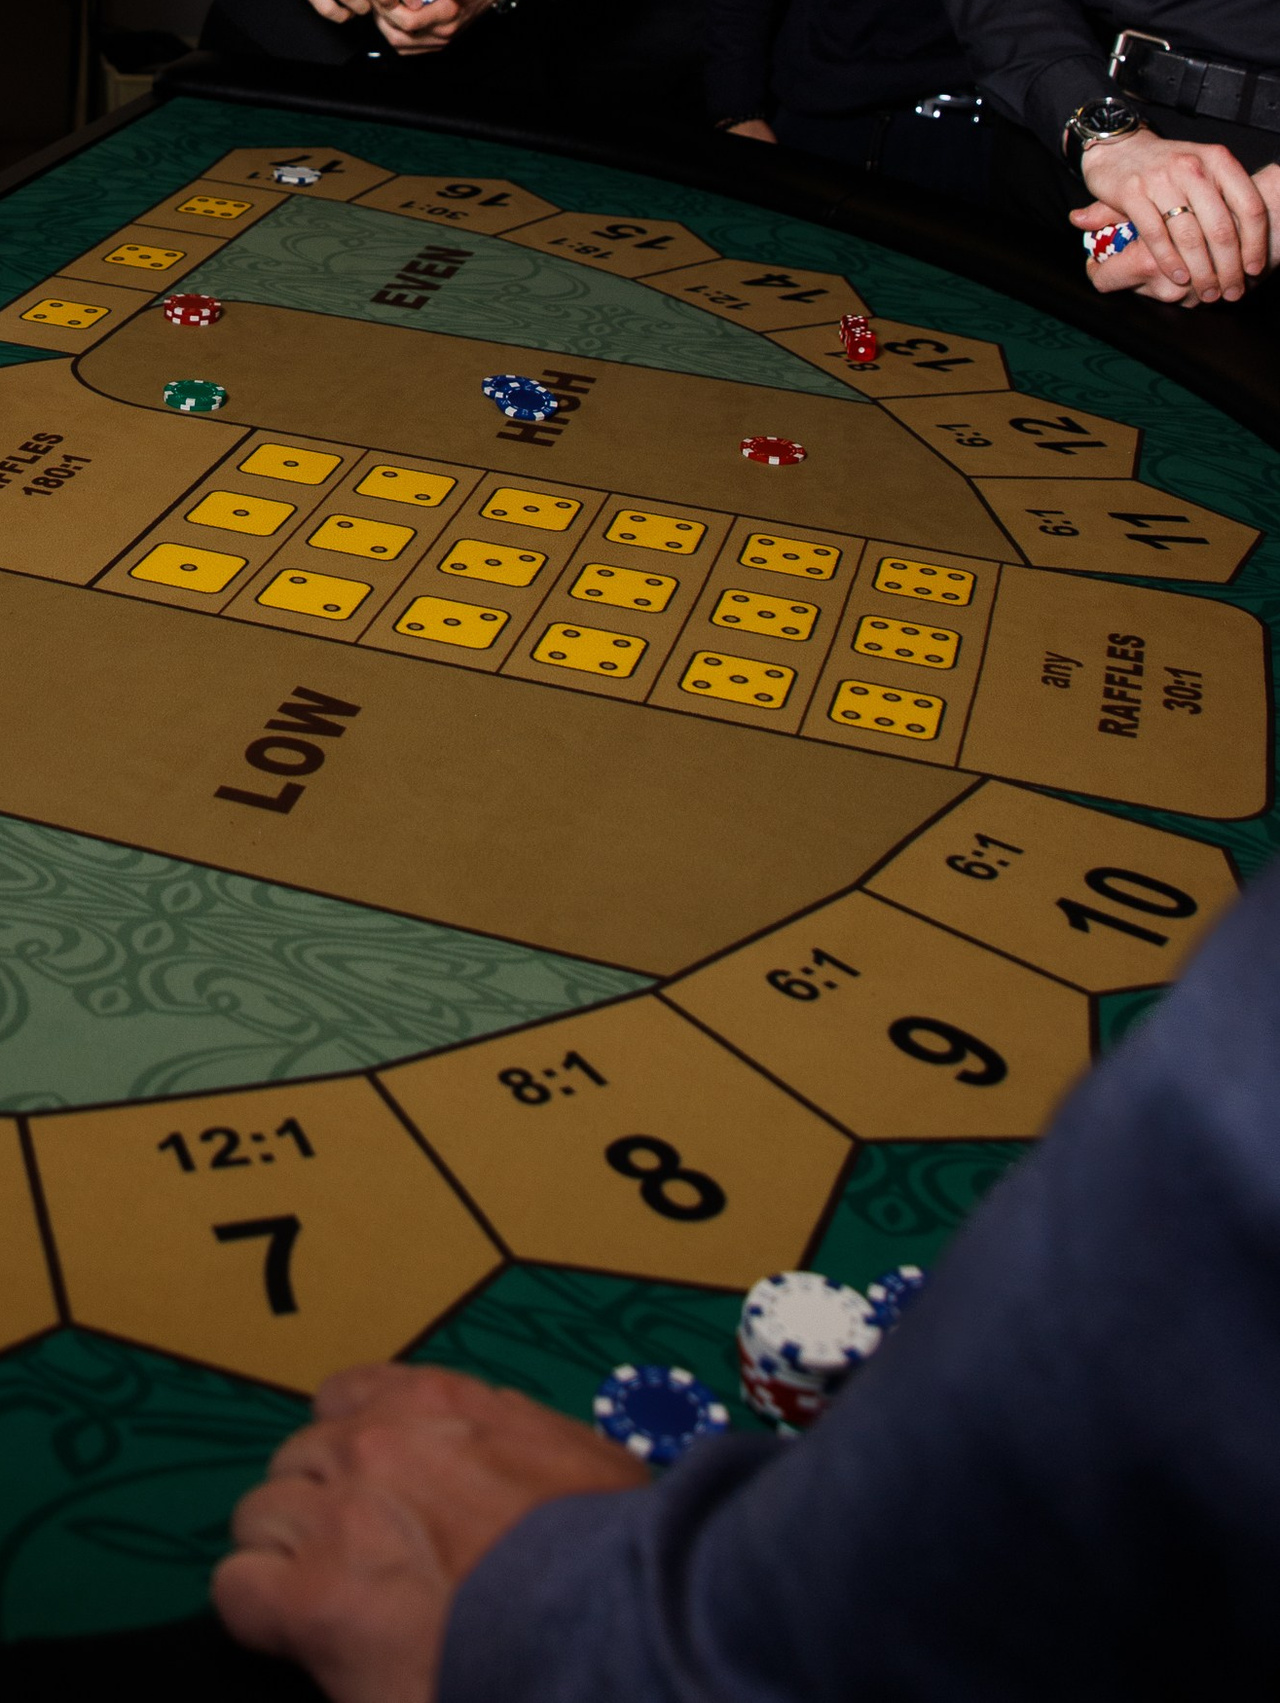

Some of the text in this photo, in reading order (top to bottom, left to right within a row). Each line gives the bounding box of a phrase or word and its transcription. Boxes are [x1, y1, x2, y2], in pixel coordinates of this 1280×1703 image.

[399, 199, 470, 221] 30:1
[435, 183, 512, 209] 16
[547, 237, 614, 260] 18:1
[591, 223, 675, 251] 15
[370, 245, 474, 310] EVEN
[684, 284, 752, 311] 12:1
[740, 273, 830, 304] 14
[884, 337, 975, 372] 13
[935, 422, 994, 449] 6:1
[1008, 414, 1105, 455] 12
[22, 454, 92, 498] 180:1
[1024, 508, 1081, 538] 6:1
[1107, 510, 1211, 551] 11
[1041, 651, 1083, 689] any
[1098, 632, 1146, 739] RAFFLES
[1162, 666, 1203, 715] 30:1
[213, 685, 362, 815] LOW
[946, 833, 1024, 880] 6:1
[1055, 866, 1198, 947] 10
[765, 947, 862, 1002] 6:1
[886, 1015, 1009, 1088] 9
[497, 1050, 609, 1106] 8:1
[156, 1117, 317, 1174] 12:1
[604, 1134, 728, 1223] 8
[210, 1213, 303, 1317] 7
